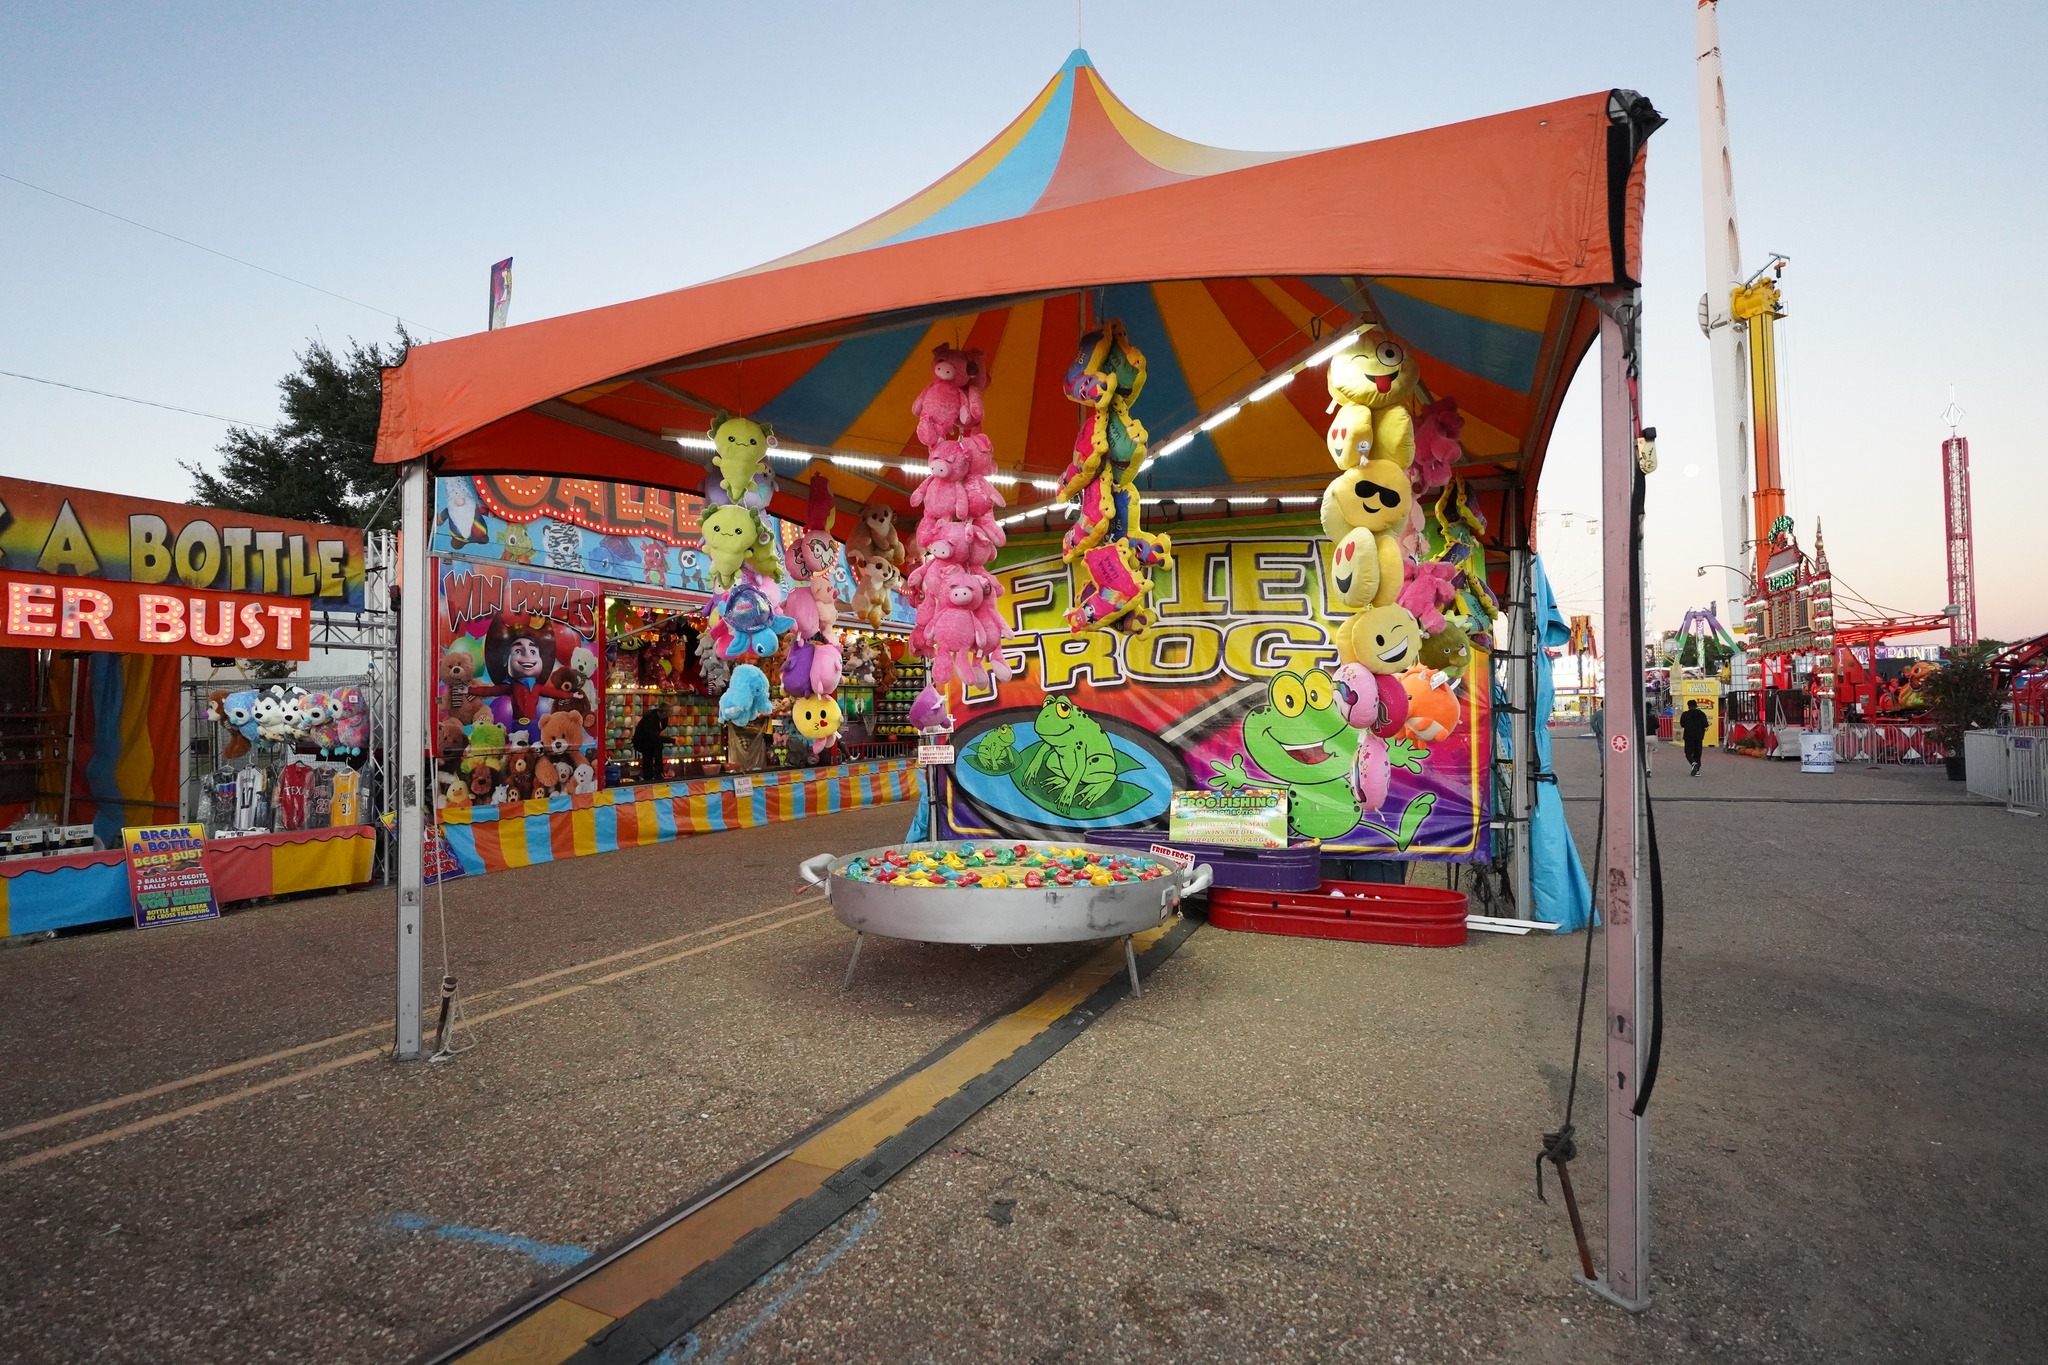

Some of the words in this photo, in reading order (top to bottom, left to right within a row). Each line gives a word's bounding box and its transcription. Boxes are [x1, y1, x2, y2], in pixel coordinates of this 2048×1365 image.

[36, 499, 101, 576] A
[129, 513, 347, 598] BOTTLE
[443, 570, 504, 632] WIN
[510, 579, 595, 640] PRIZES
[139, 593, 302, 650] BUST
[316, 800, 330, 814] 23
[1180, 797, 1217, 808] FROG
[1220, 797, 1279, 808] FISHING
[140, 828, 192, 840] BREAK
[132, 843, 144, 854] A
[148, 838, 203, 852] BOTTLE
[1152, 846, 1170, 857] FRIED
[133, 854, 168, 868] BEER
[171, 848, 203, 861] BUST
[144, 876, 167, 884] BALLS
[177, 872, 207, 881] CREDITS
[180, 878, 210, 886] CREDITS
[146, 908, 170, 916] BOTTLE
[156, 912, 177, 920] CROSS
[178, 908, 210, 917] THROWING
